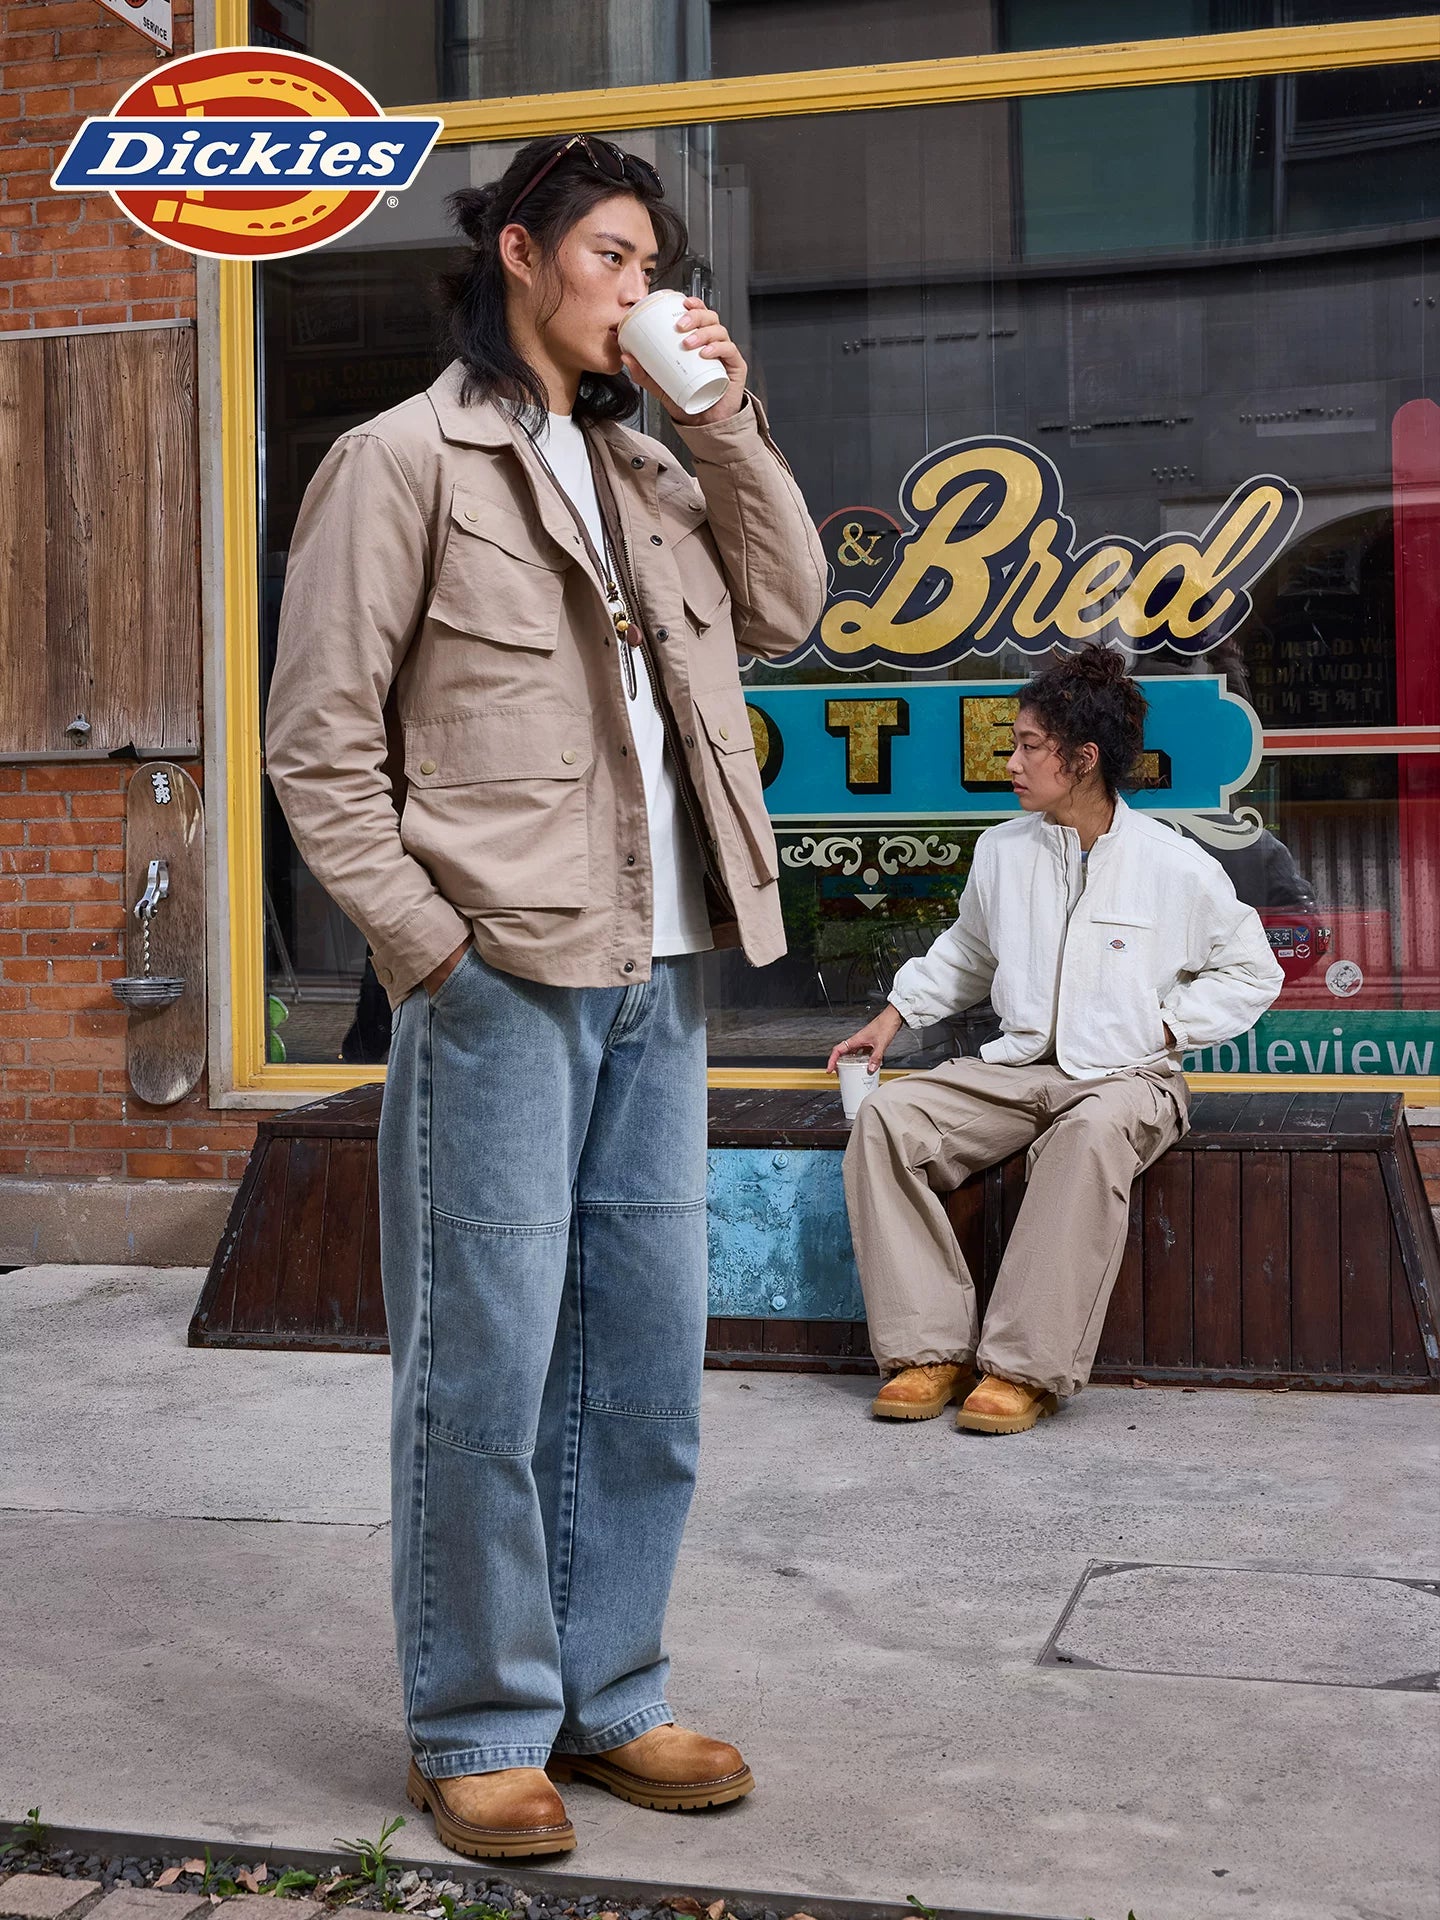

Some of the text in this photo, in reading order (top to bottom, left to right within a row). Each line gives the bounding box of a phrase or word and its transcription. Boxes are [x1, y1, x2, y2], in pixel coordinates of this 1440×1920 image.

[143, 16, 168, 41] SERVICE
[821, 447, 1283, 655] & Bred
